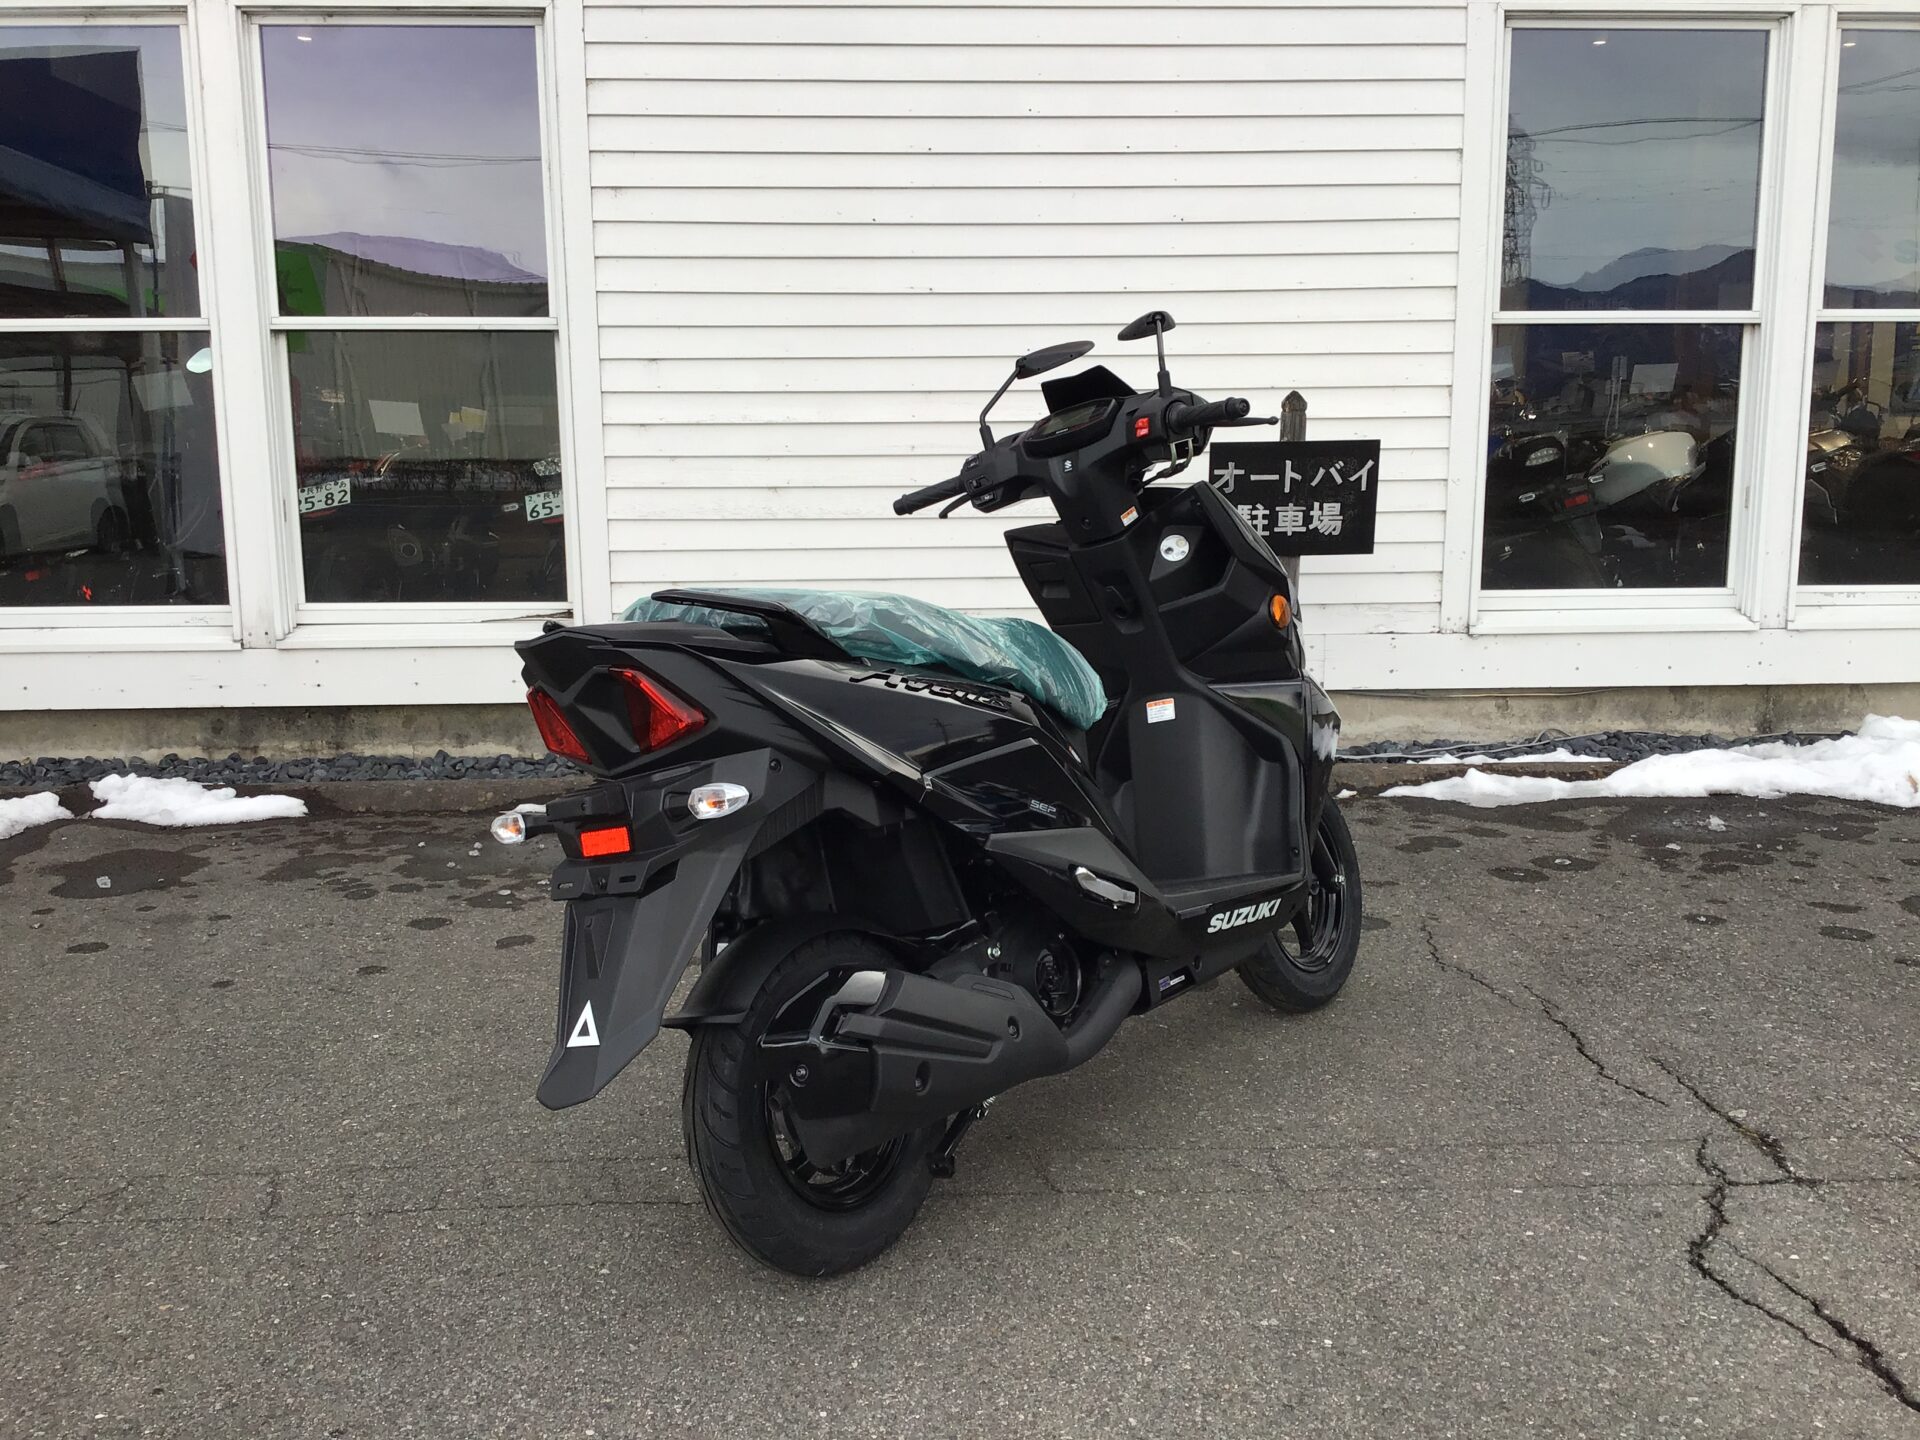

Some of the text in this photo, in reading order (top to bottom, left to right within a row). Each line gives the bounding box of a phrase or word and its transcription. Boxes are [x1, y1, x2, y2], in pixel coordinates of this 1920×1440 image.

[1212, 460, 1375, 494] オートバイ
[299, 489, 349, 512] 5-82
[1237, 501, 1344, 537] 駐車場
[1030, 799, 1057, 813] SEP
[1207, 898, 1282, 934] SUZUKI
